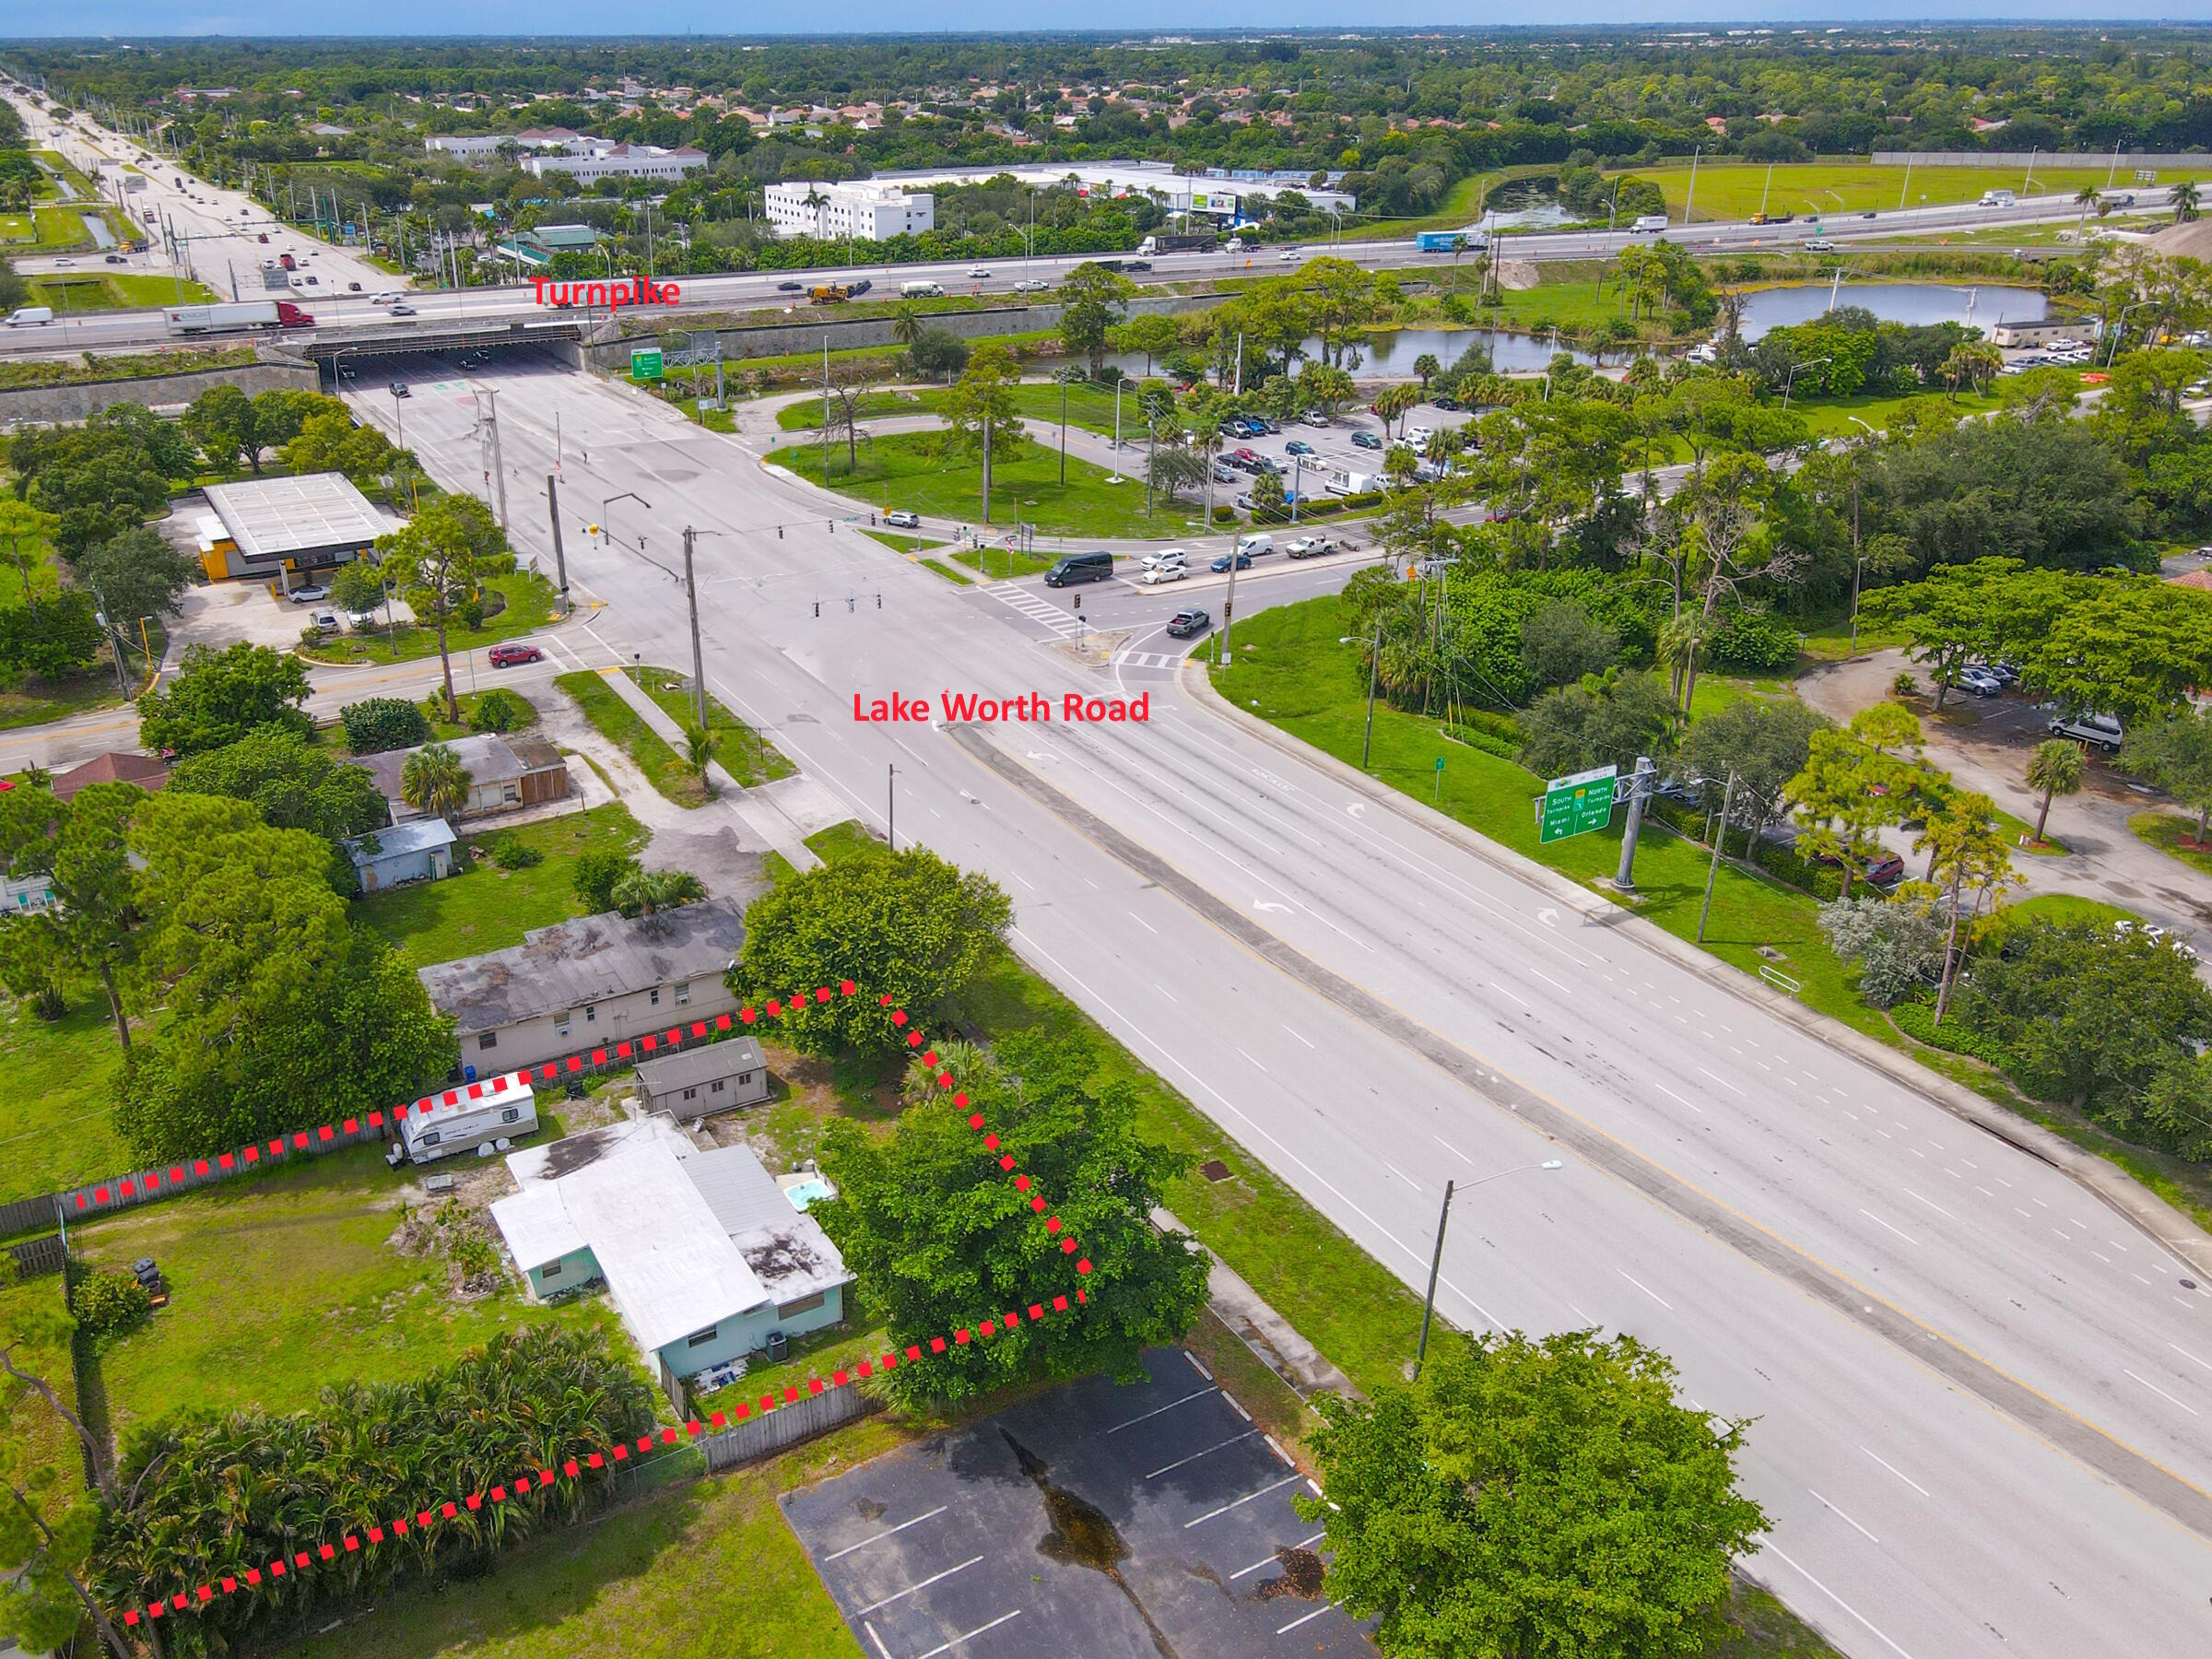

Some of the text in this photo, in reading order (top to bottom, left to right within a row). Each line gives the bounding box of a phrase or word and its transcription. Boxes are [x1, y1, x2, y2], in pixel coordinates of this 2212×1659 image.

[1552, 796, 1571, 806] SOUTH
[1582, 807, 1606, 818] Orlando
[1550, 817, 1570, 826] Miami
